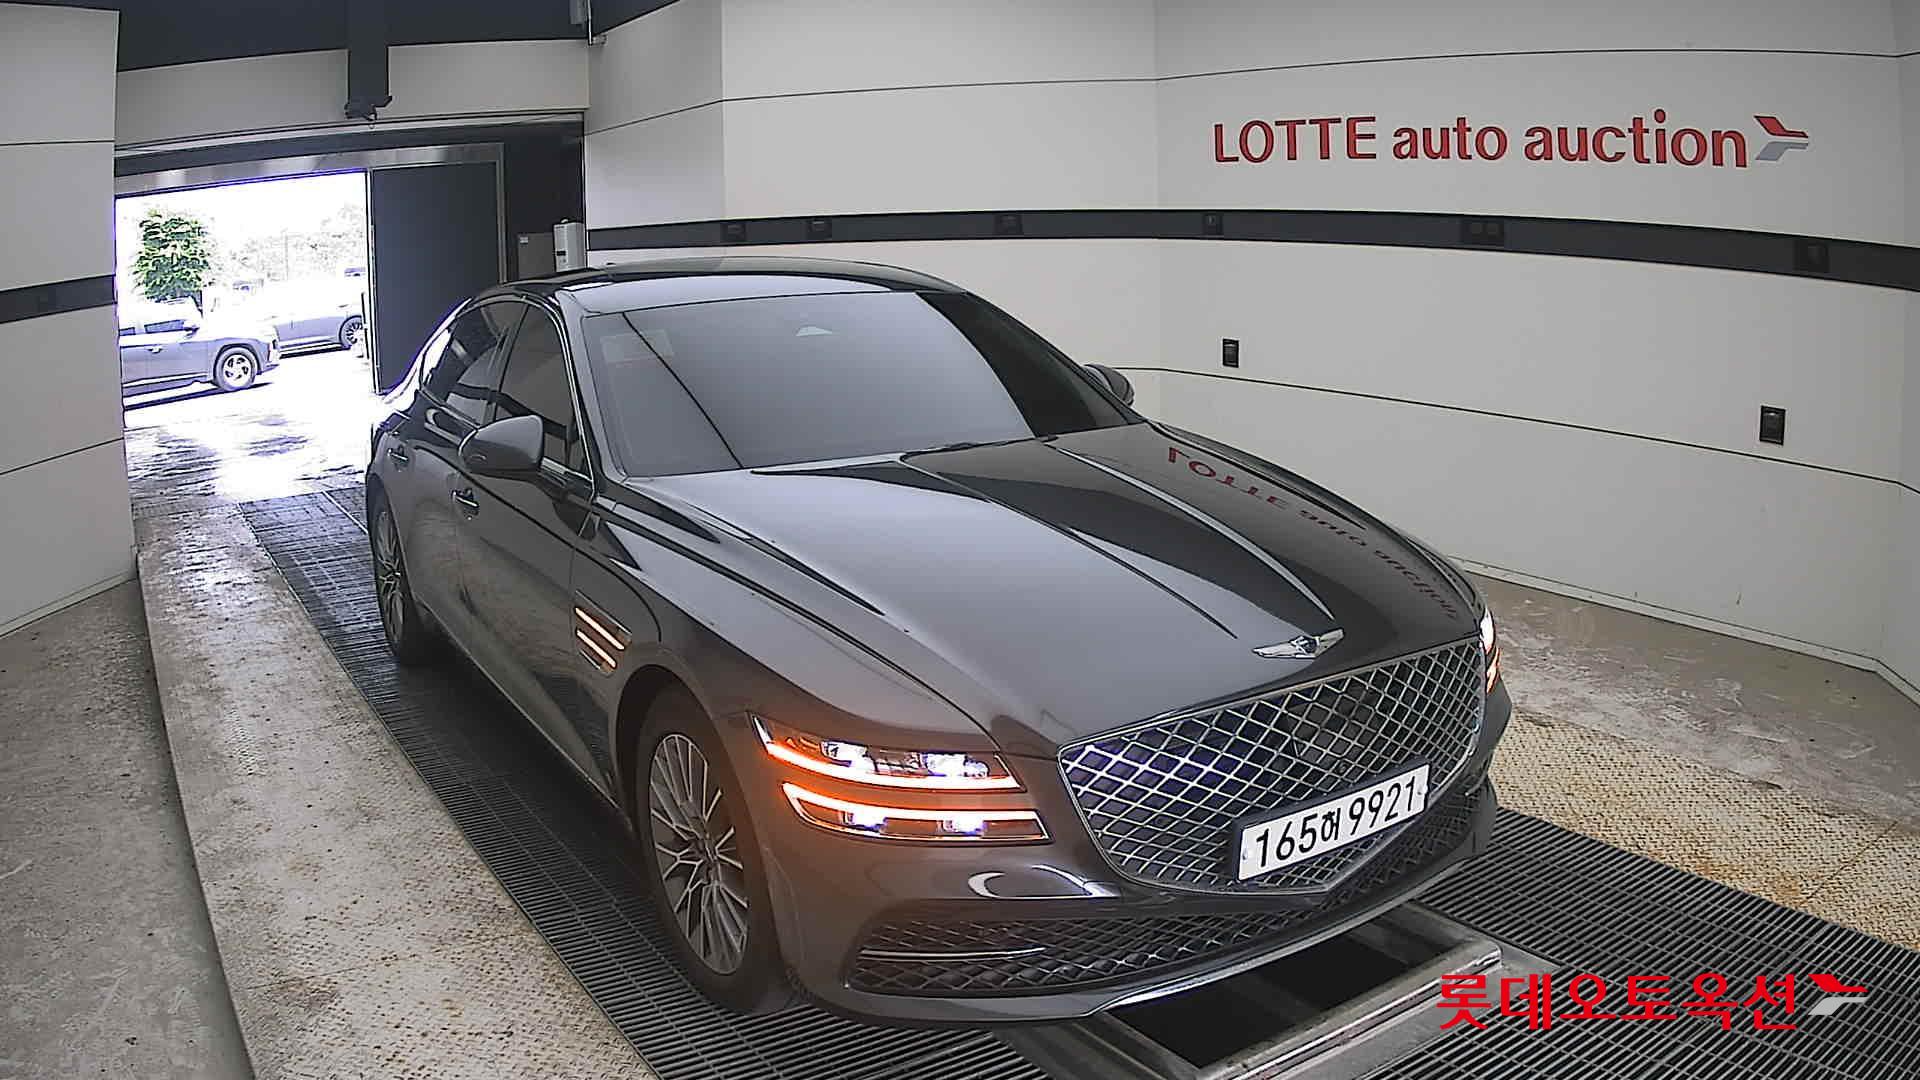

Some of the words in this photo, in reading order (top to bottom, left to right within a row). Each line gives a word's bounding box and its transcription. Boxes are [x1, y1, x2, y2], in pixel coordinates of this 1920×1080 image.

[1214, 116, 1377, 163] LOTTE
[1392, 117, 1507, 161] auto
[1523, 109, 1748, 168] auction
[1256, 807, 1341, 868] 165허
[1349, 775, 1416, 836] 9921
